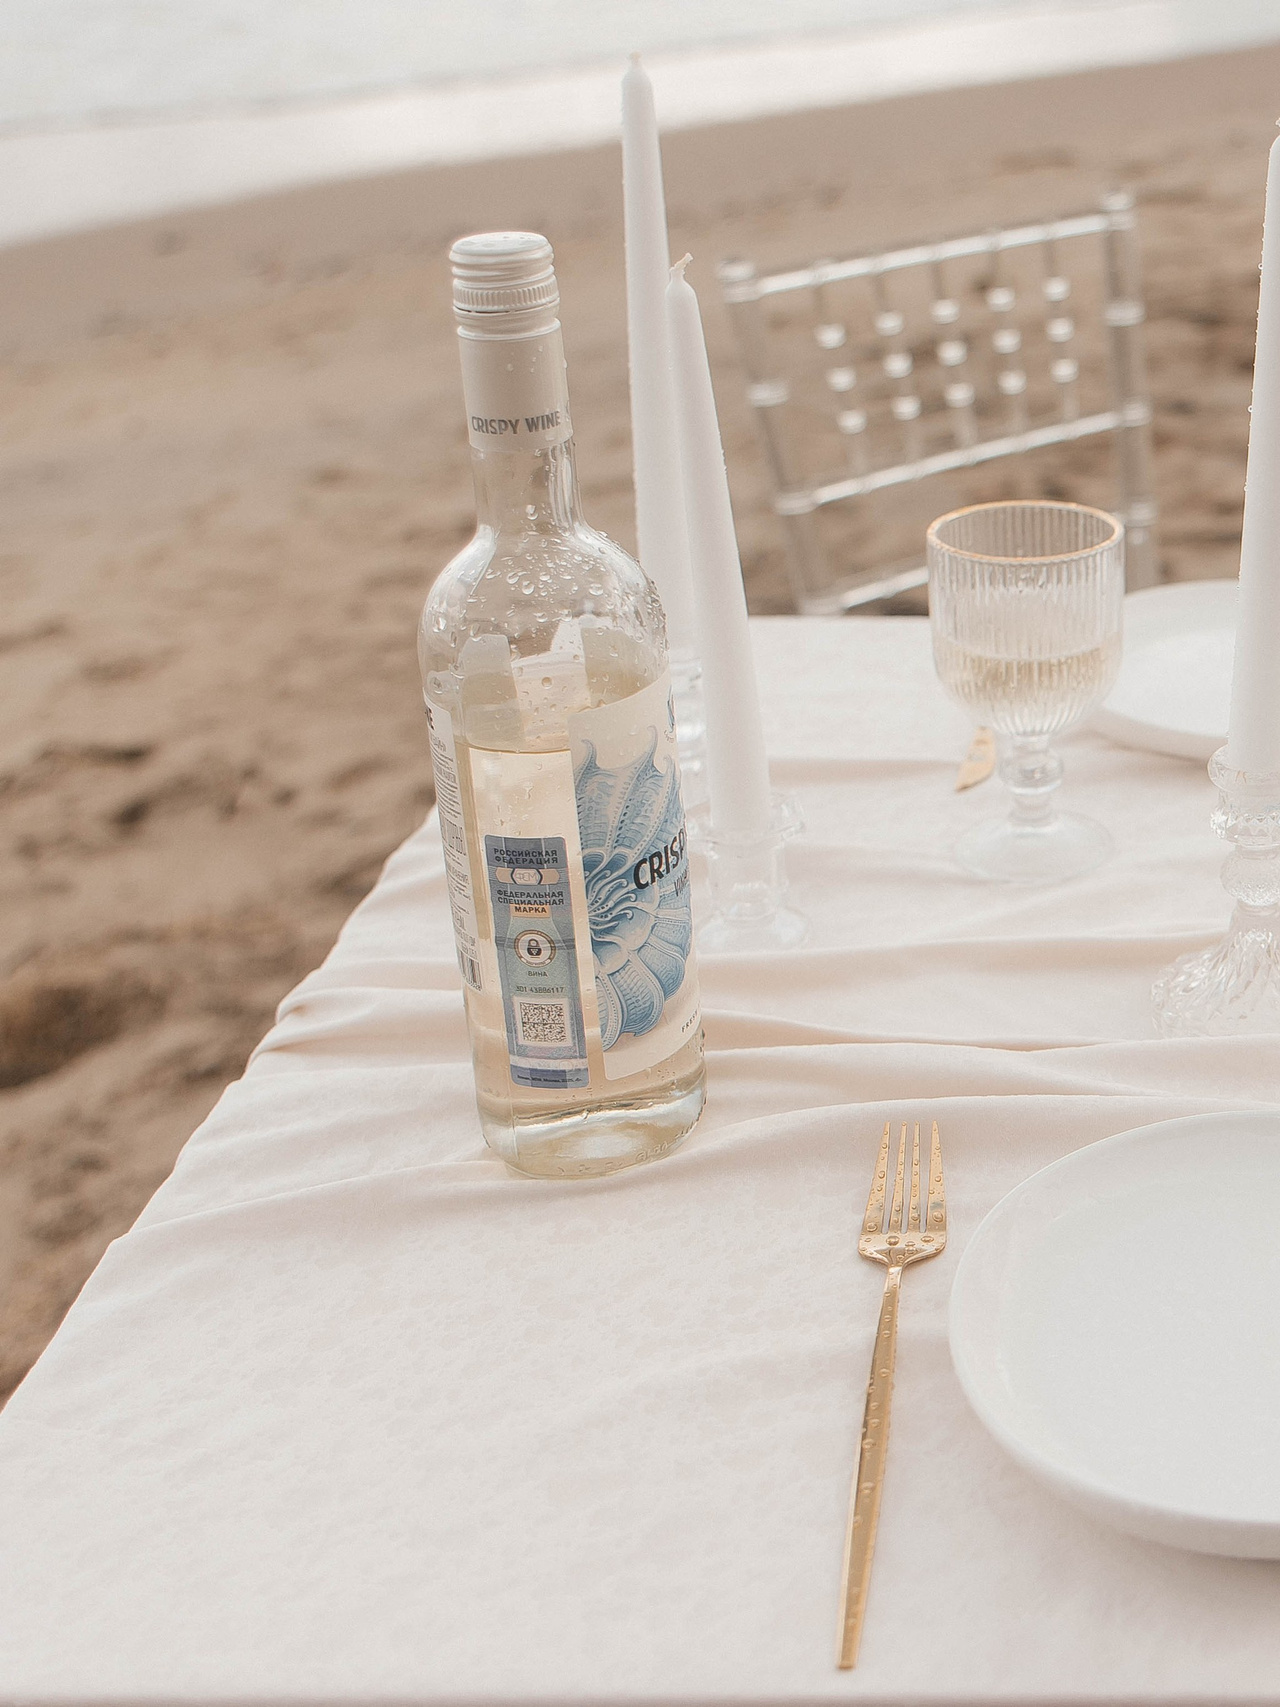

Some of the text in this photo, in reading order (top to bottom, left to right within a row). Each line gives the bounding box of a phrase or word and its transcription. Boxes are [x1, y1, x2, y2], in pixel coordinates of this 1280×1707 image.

[472, 411, 561, 435] CRISPY WINE
[493, 848, 558, 858] РОССИЙСКАЯ
[633, 826, 686, 890] CRISP
[494, 856, 559, 865] ФЕДЕРАЦИЯ
[496, 889, 564, 899] ФЕДЕРАЛЬНАЯ
[497, 897, 565, 906] СПЕЦИАЛЬНАЯ
[514, 906, 548, 914] МАРКА
